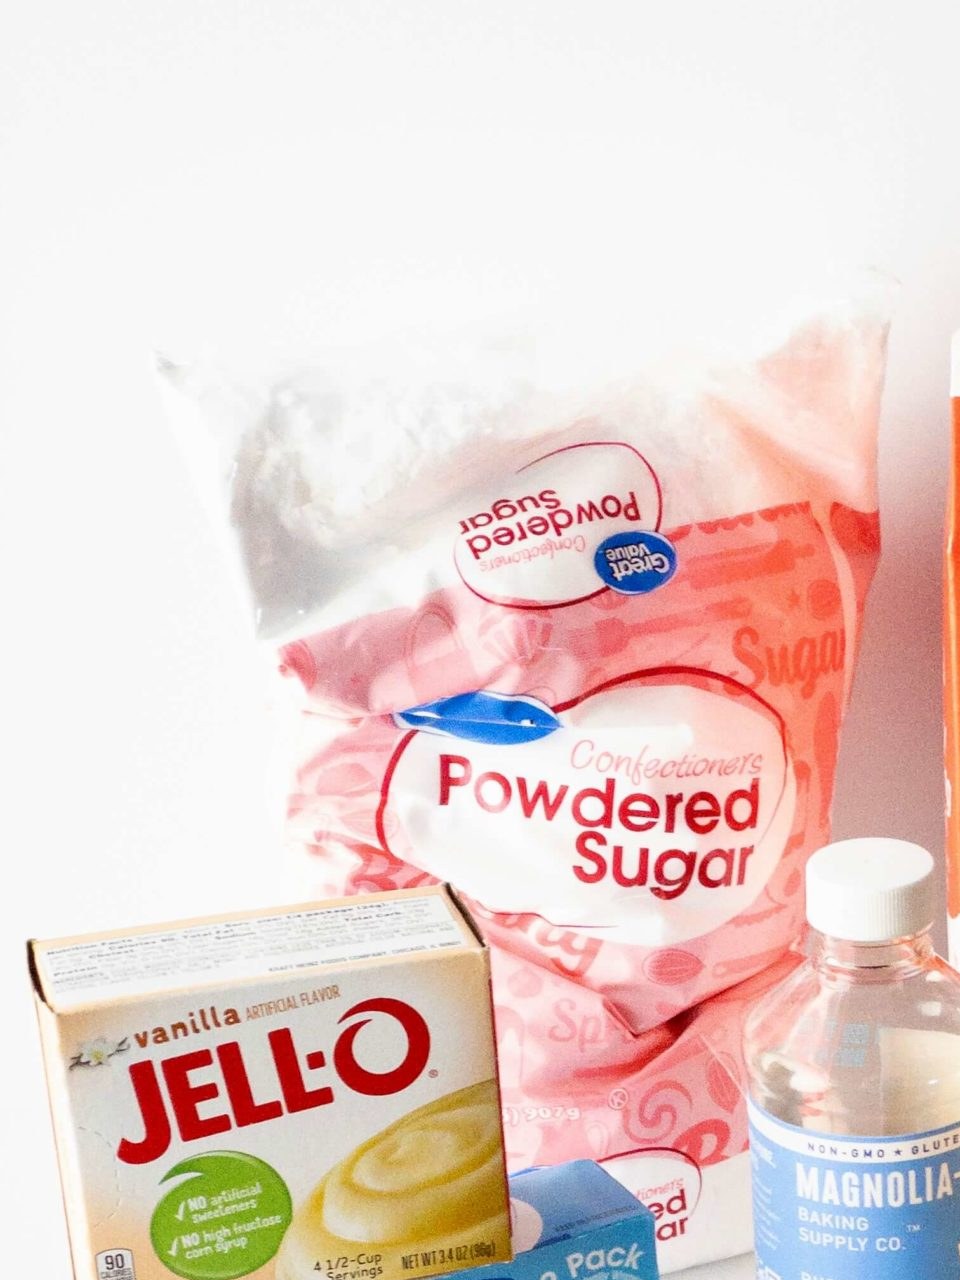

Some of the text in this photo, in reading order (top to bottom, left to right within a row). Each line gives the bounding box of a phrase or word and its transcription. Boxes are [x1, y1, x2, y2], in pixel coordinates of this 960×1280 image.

[458, 489, 562, 535] Sugar
[466, 491, 642, 560] Powdered
[480, 535, 587, 573] Confectioners
[605, 543, 652, 562] Value
[608, 553, 671, 581] Great
[569, 739, 764, 786] Confectioners
[438, 753, 761, 835] Powdered
[571, 829, 757, 900] Sugar
[134, 984, 341, 1049] vanilla ARTIFICIAL FLAVOR
[117, 997, 431, 1165] JELL-O
[523, 1107, 581, 1122] 907g
[187, 1182, 263, 1212] NO artificial
[191, 1199, 257, 1224] sweeteners
[181, 1215, 282, 1249] NO high fructose
[797, 1206, 869, 1231] BAKING
[185, 1236, 249, 1260] corn syrup
[797, 1227, 906, 1252] SUPPLY CO.
[105, 1253, 125, 1270] 90
[313, 1252, 383, 1271] 4 1/2-Cup
[401, 1253, 419, 1270] NET
[420, 1250, 437, 1267] WT
[439, 1247, 453, 1264] 3.4
[455, 1245, 468, 1261] OZ
[566, 1242, 645, 1278] Pack
